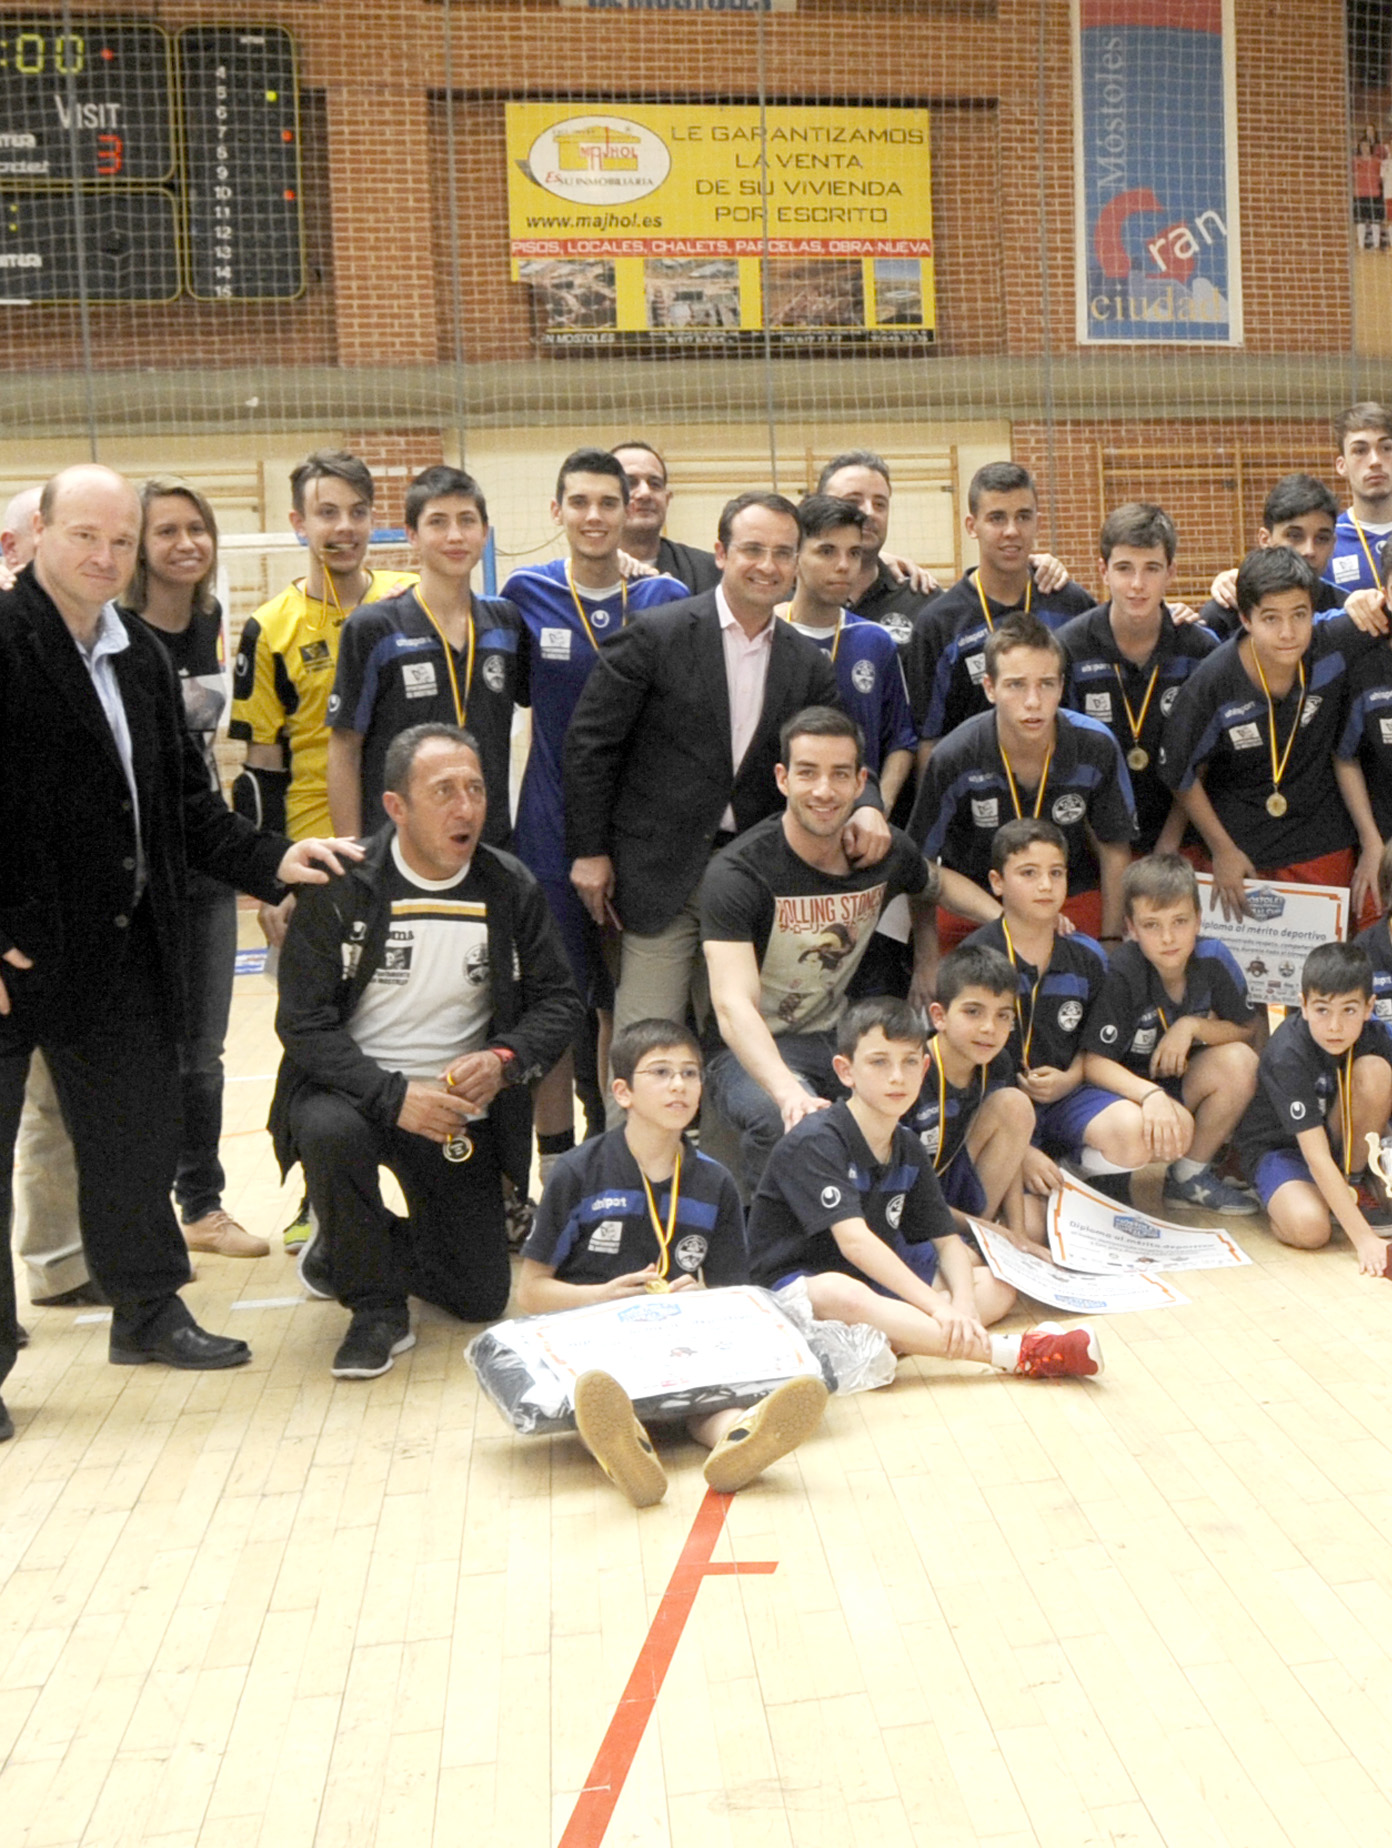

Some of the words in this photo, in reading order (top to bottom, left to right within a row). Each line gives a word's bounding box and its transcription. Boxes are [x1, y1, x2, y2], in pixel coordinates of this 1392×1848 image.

[215, 66, 226, 78] 4
[216, 86, 226, 100] 5
[216, 106, 228, 119] 6
[1095, 35, 1126, 189] Móstoles
[217, 125, 227, 138] 7
[671, 126, 703, 141] LE
[711, 126, 924, 145] GARANTIZAMOS
[97, 134, 123, 174] 3
[735, 153, 769, 169] LA
[776, 154, 864, 169] VENTA
[217, 166, 229, 180] 9
[214, 186, 232, 199] 10
[696, 179, 731, 195] DE
[739, 180, 774, 196] SU
[784, 180, 904, 197] VIVIENDA
[215, 207, 231, 218] 11
[715, 207, 768, 222] POR
[777, 207, 888, 223] ESCRITO
[526, 212, 663, 231] www.majhol.es
[215, 226, 232, 239] 12
[215, 246, 232, 259] 13
[568, 240, 648, 254] LOCALES,
[651, 240, 732, 254] CHALETS,
[829, 240, 874, 253] OBRA
[877, 241, 931, 254] NUEVA
[215, 266, 232, 279] 14
[215, 285, 232, 298] 15
[1090, 285, 1222, 321] ciudad
